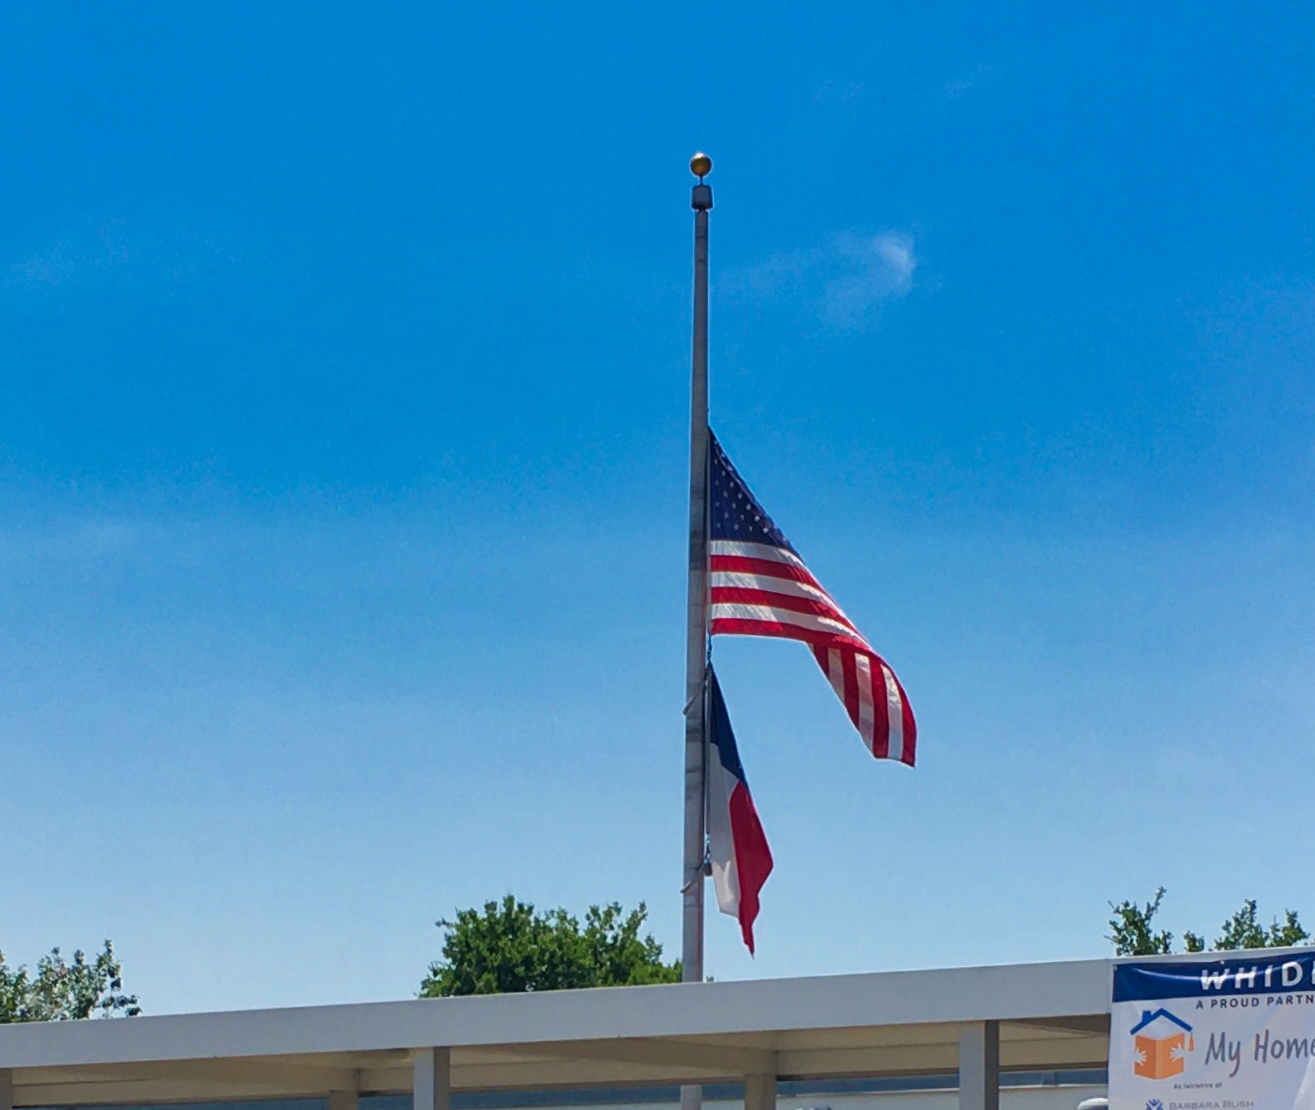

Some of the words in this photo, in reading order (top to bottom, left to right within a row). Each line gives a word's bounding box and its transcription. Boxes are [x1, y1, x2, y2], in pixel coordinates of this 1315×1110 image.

[1195, 1000, 1204, 1010] A
[1210, 997, 1260, 1009] PROUD
[1205, 1031, 1241, 1078] My
